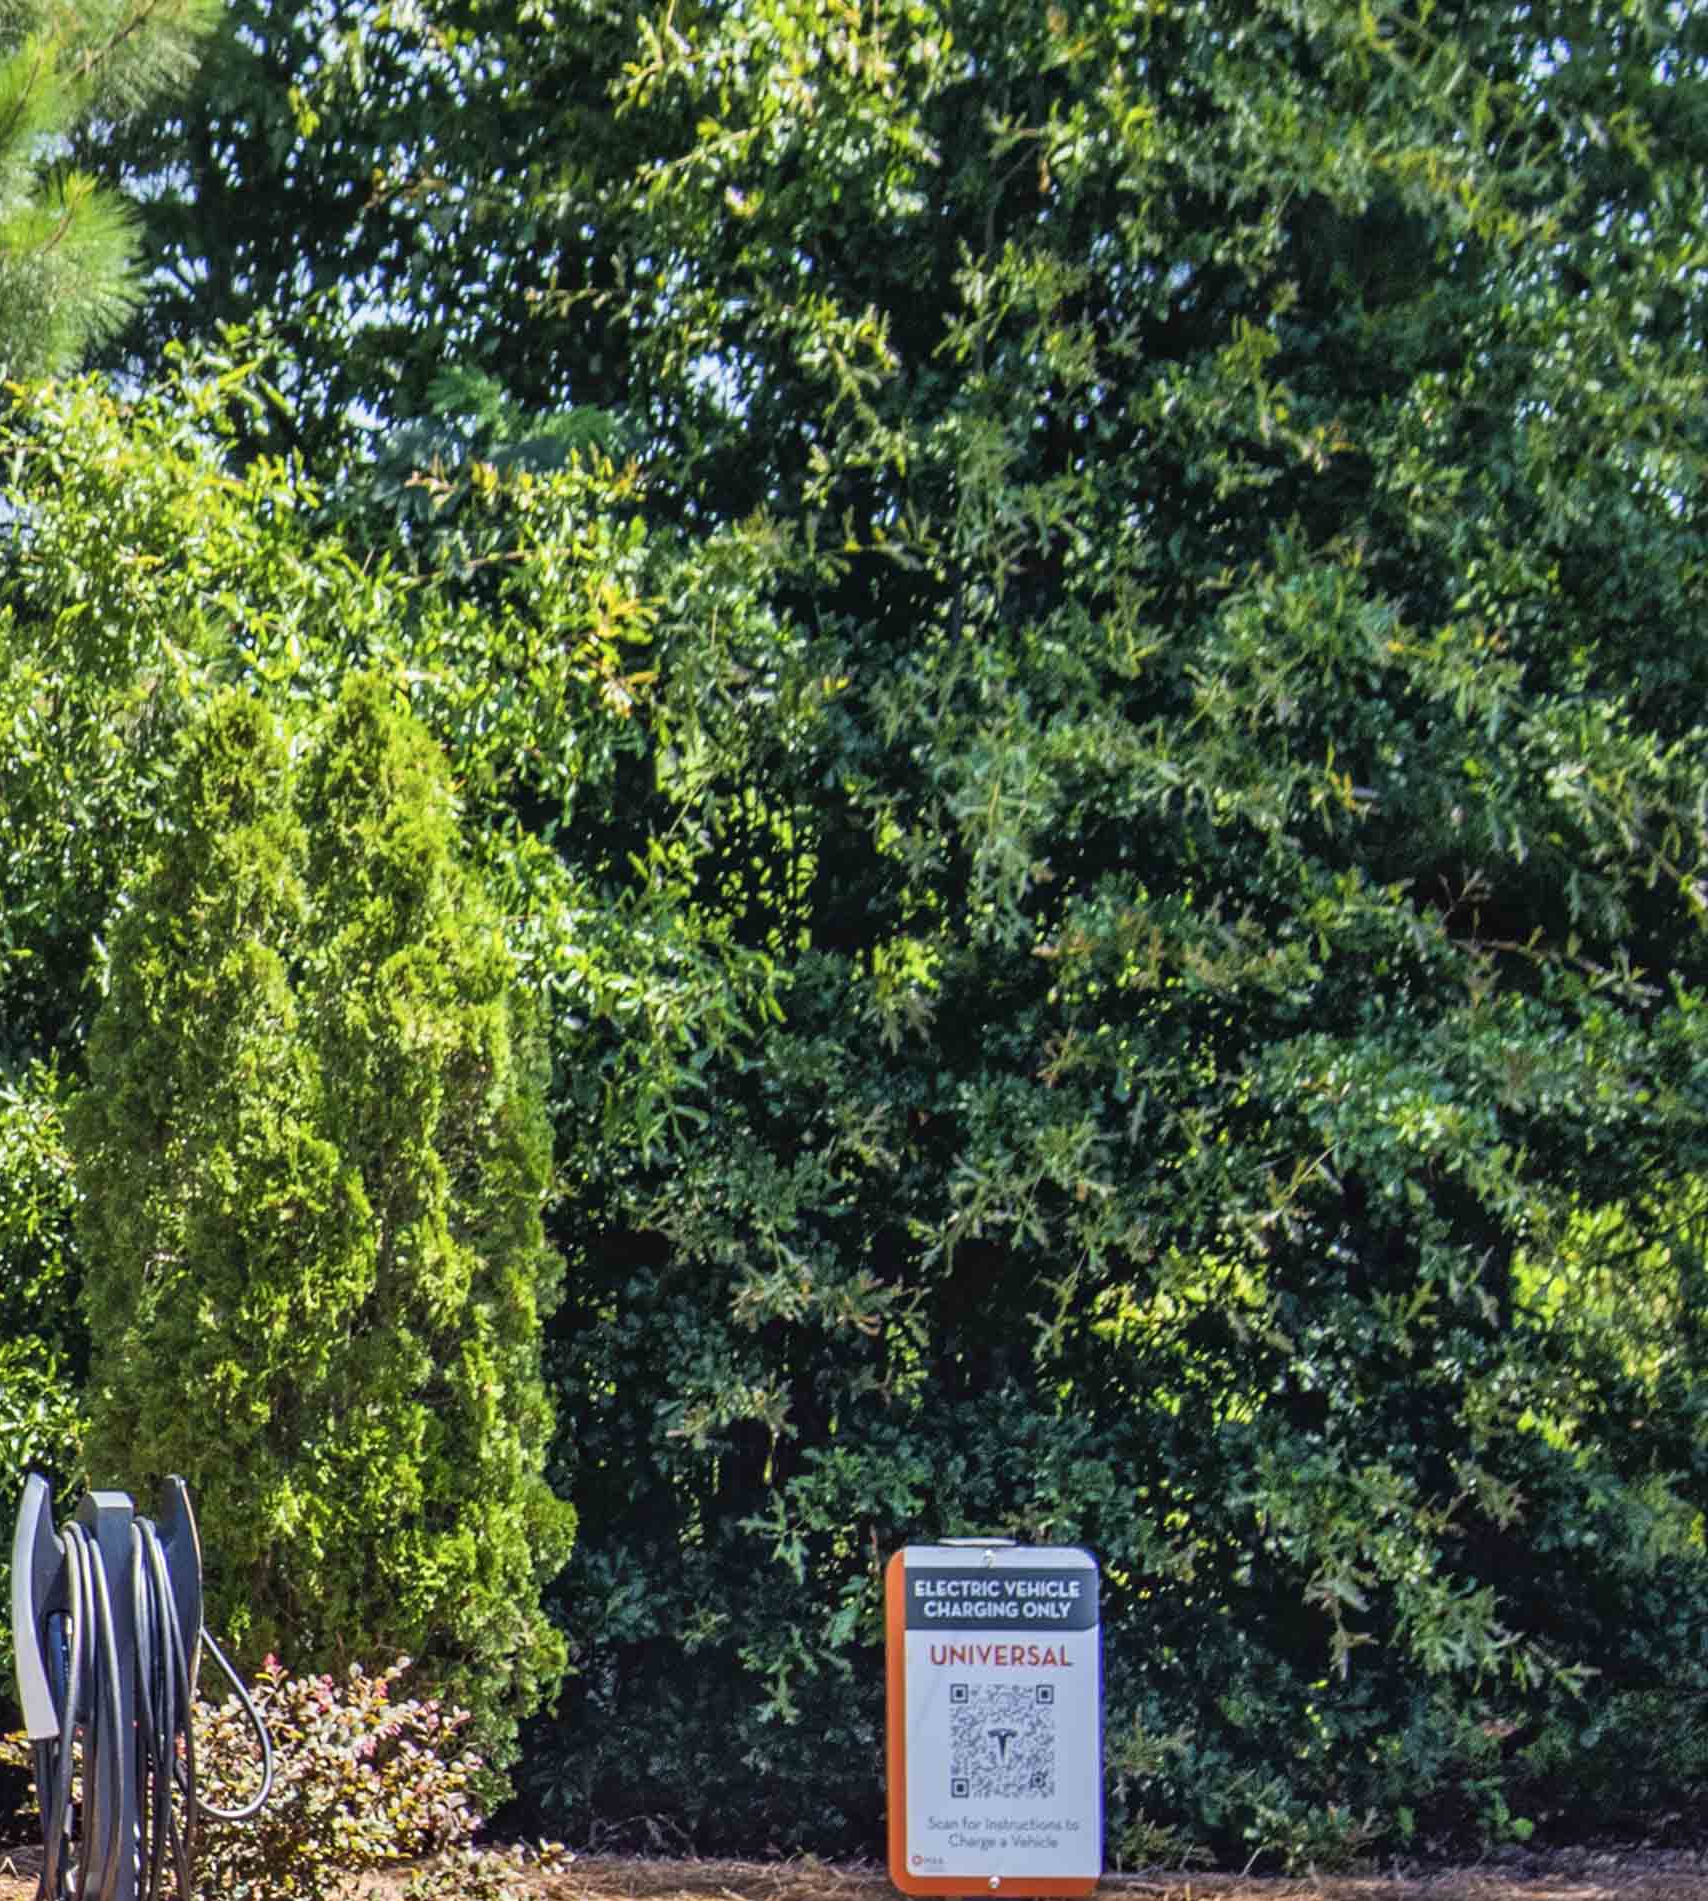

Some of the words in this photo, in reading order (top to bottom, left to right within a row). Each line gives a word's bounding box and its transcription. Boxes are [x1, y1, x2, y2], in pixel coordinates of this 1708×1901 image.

[915, 1580, 1000, 1598] ELECTRIC
[1004, 1580, 1080, 1598] VEHICLE
[924, 1601, 1019, 1618] CHARGING
[1023, 1601, 1071, 1618] ONLY
[930, 1645, 1073, 1666] UNIVERSAL
[928, 1816, 959, 1830] Scan
[962, 1816, 980, 1830] for
[986, 1817, 1062, 1831] Instructions
[1066, 1818, 1079, 1831] to
[948, 1833, 996, 1850] Charge
[1000, 1838, 1007, 1848] a
[1011, 1834, 1059, 1848] Vehicle
